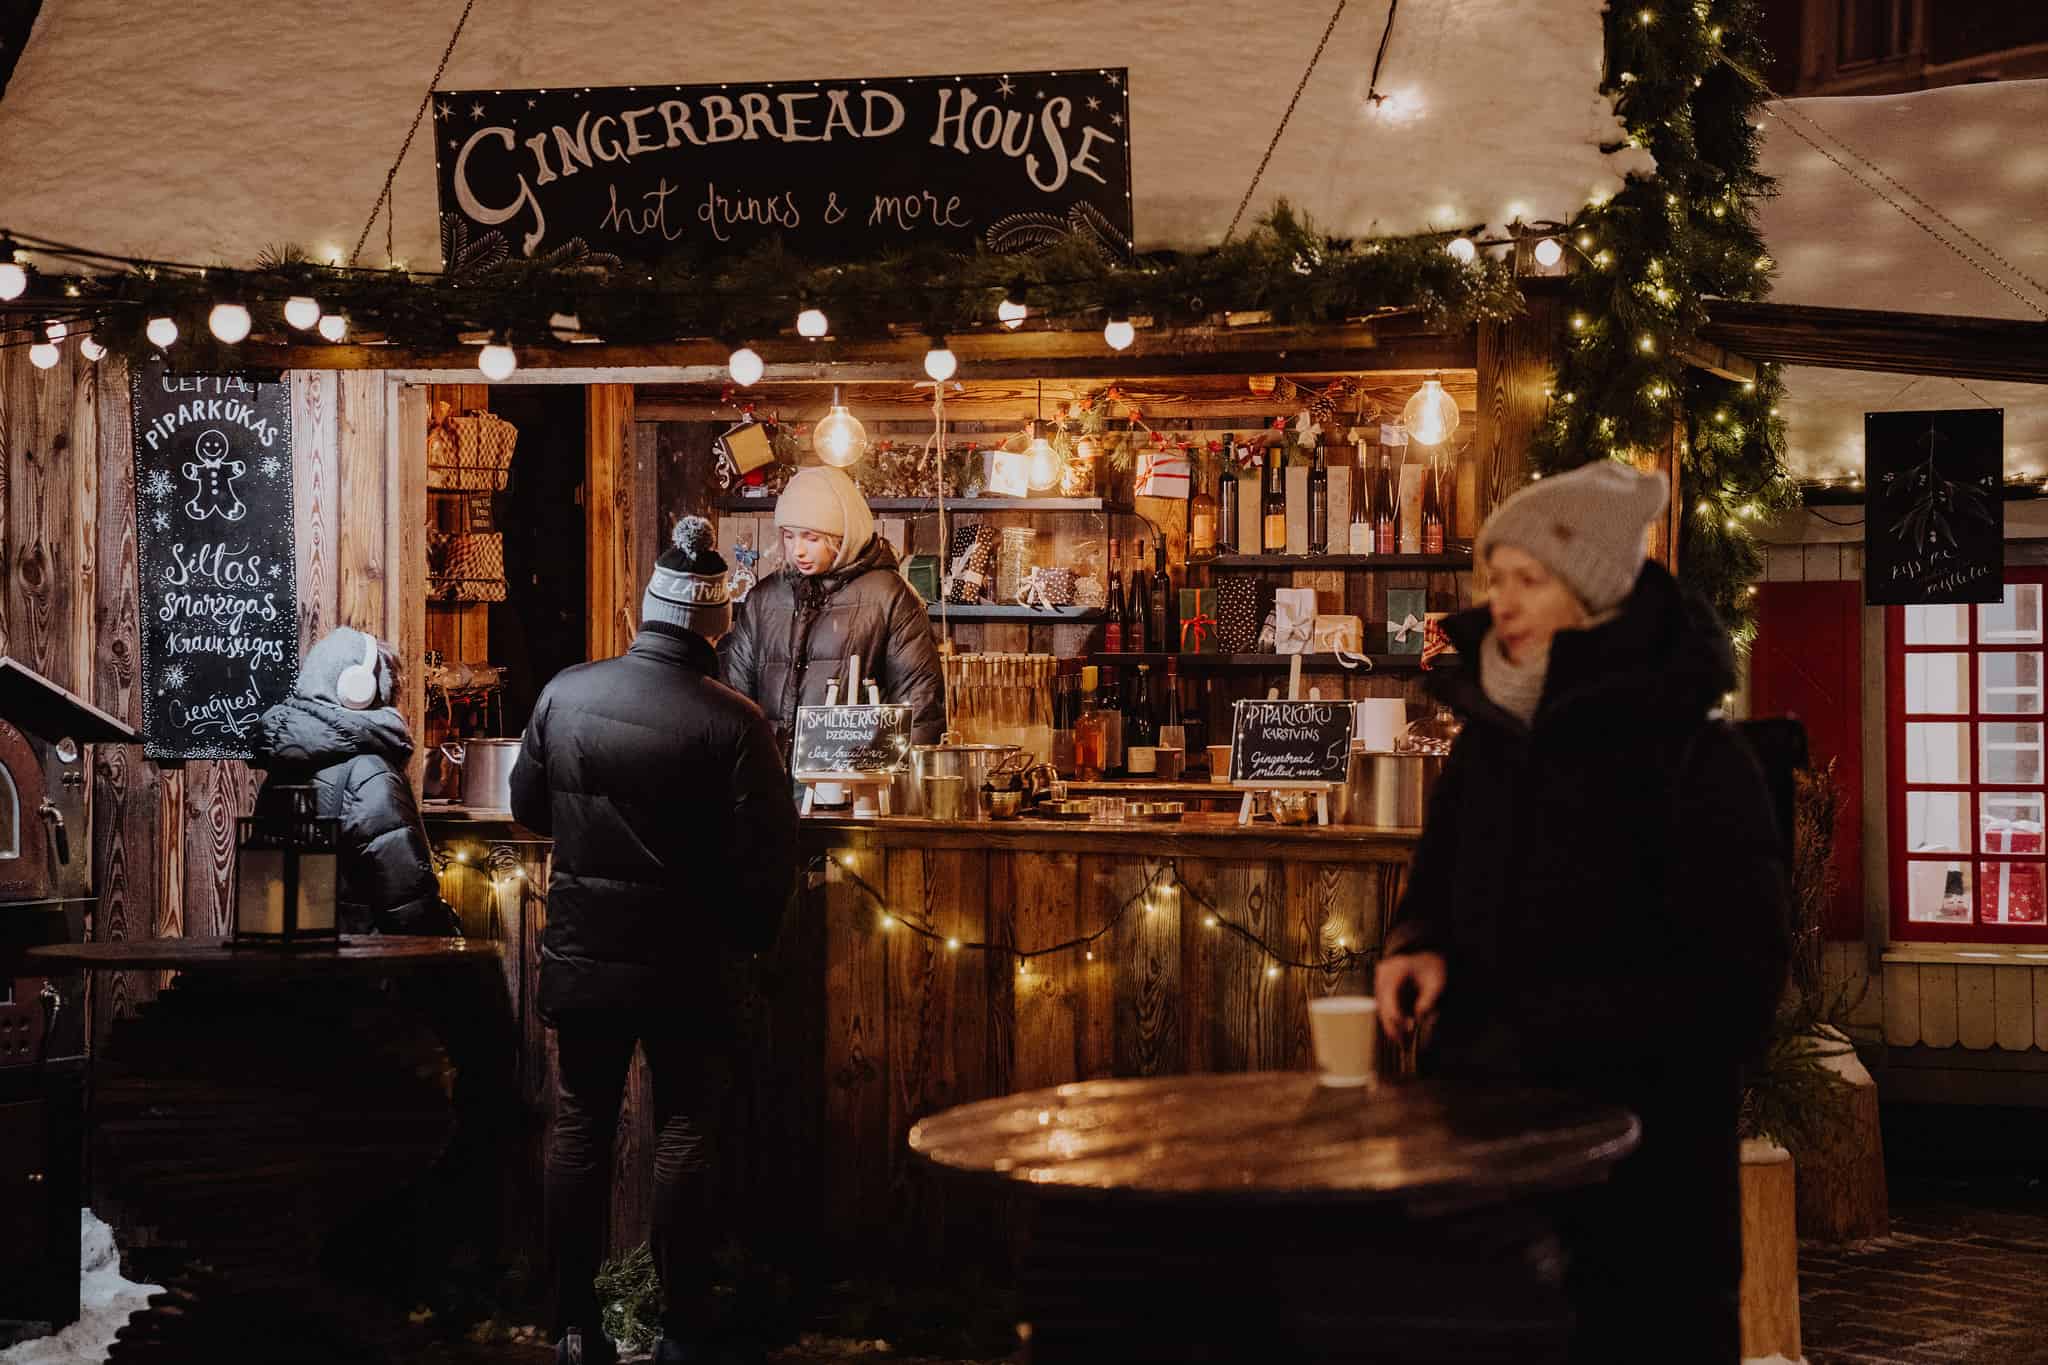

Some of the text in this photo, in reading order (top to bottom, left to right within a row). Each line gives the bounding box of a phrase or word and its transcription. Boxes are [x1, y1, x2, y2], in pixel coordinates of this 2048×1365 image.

[454, 86, 1116, 258] GINGERBREAD HOUSE
[600, 178, 973, 241] hot drinks & more
[145, 399, 278, 450] PIPARKŪKAS
[164, 542, 261, 589] Siltas
